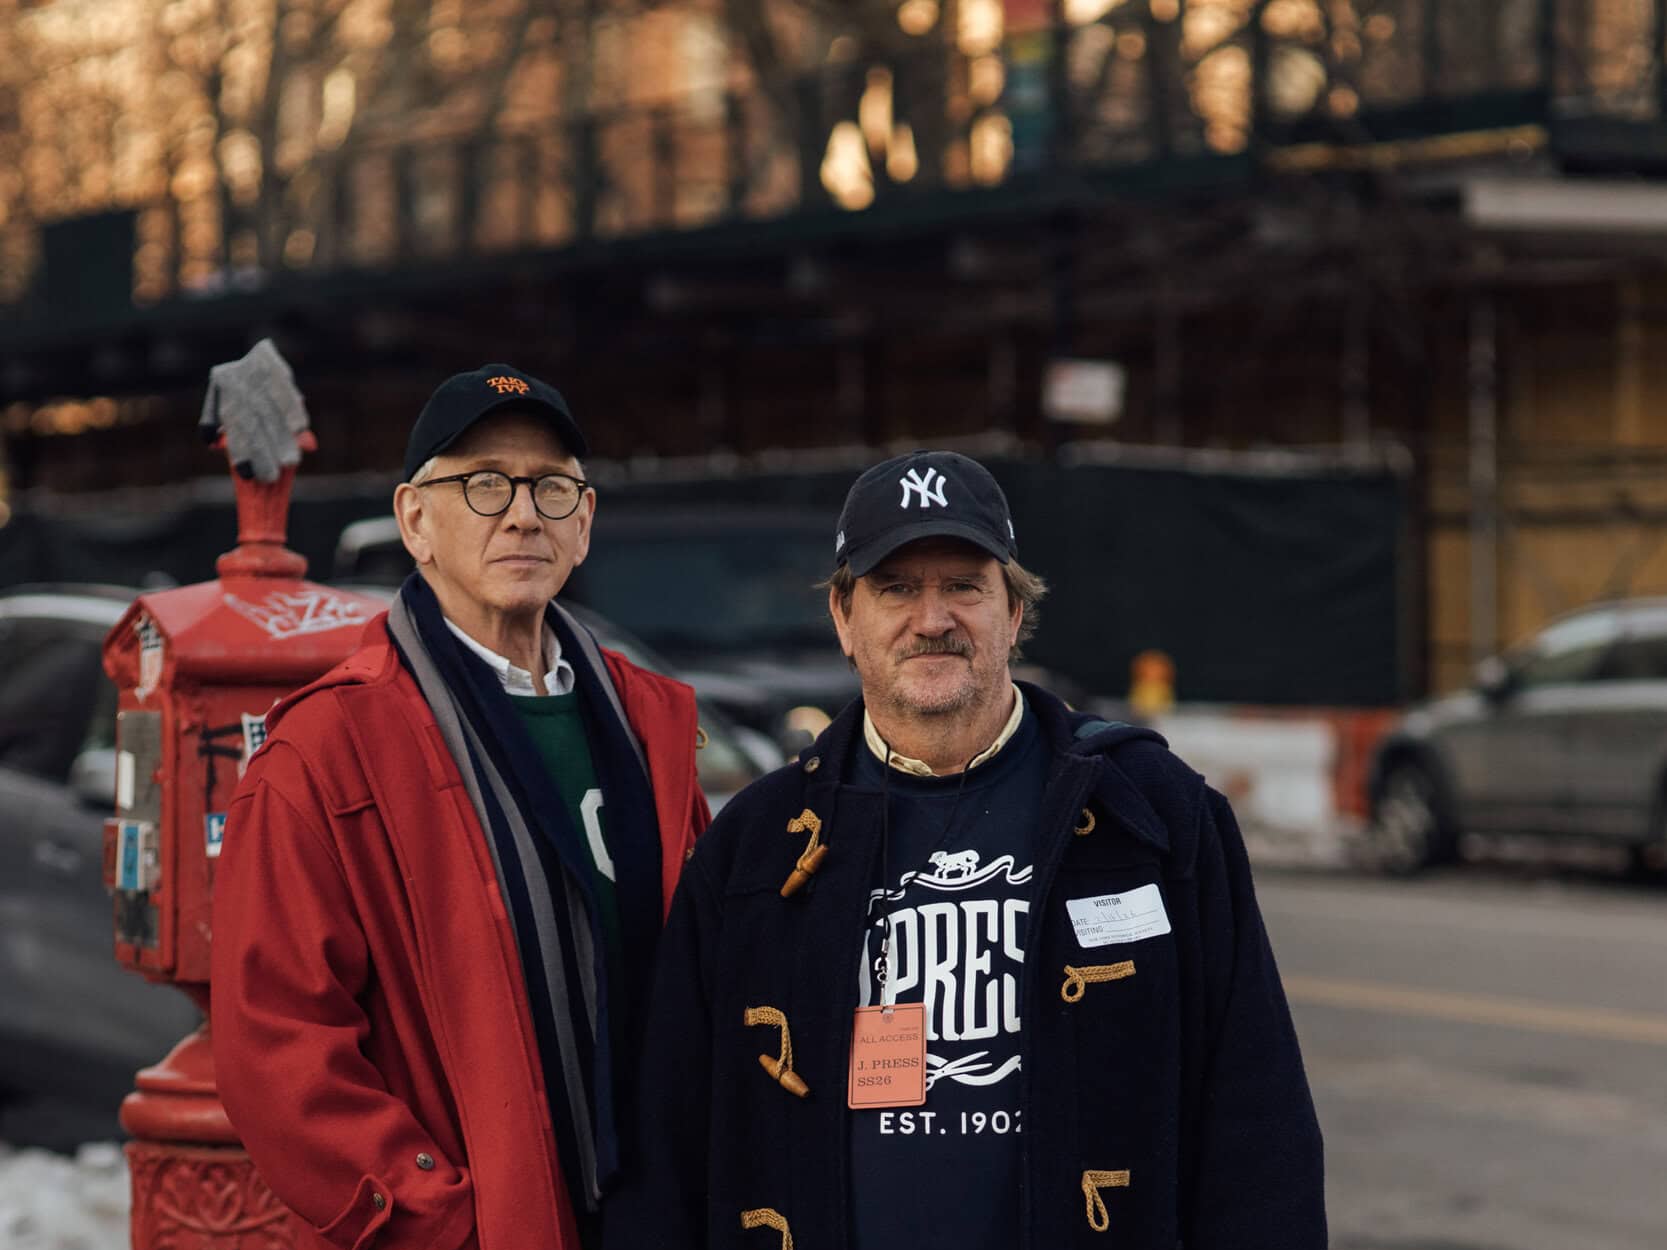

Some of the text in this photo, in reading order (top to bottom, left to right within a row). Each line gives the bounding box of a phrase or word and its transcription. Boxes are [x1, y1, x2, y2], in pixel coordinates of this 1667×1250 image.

[486, 376, 529, 389] TAKE
[496, 383, 529, 395] IVY
[899, 467, 949, 509] NY
[1093, 897, 1122, 907] VISITOR
[859, 1033, 919, 1044] ALL ACCESS
[857, 1057, 919, 1071] J. PRESS
[857, 1075, 892, 1087] SS26
[879, 1111, 947, 1135] EST.
